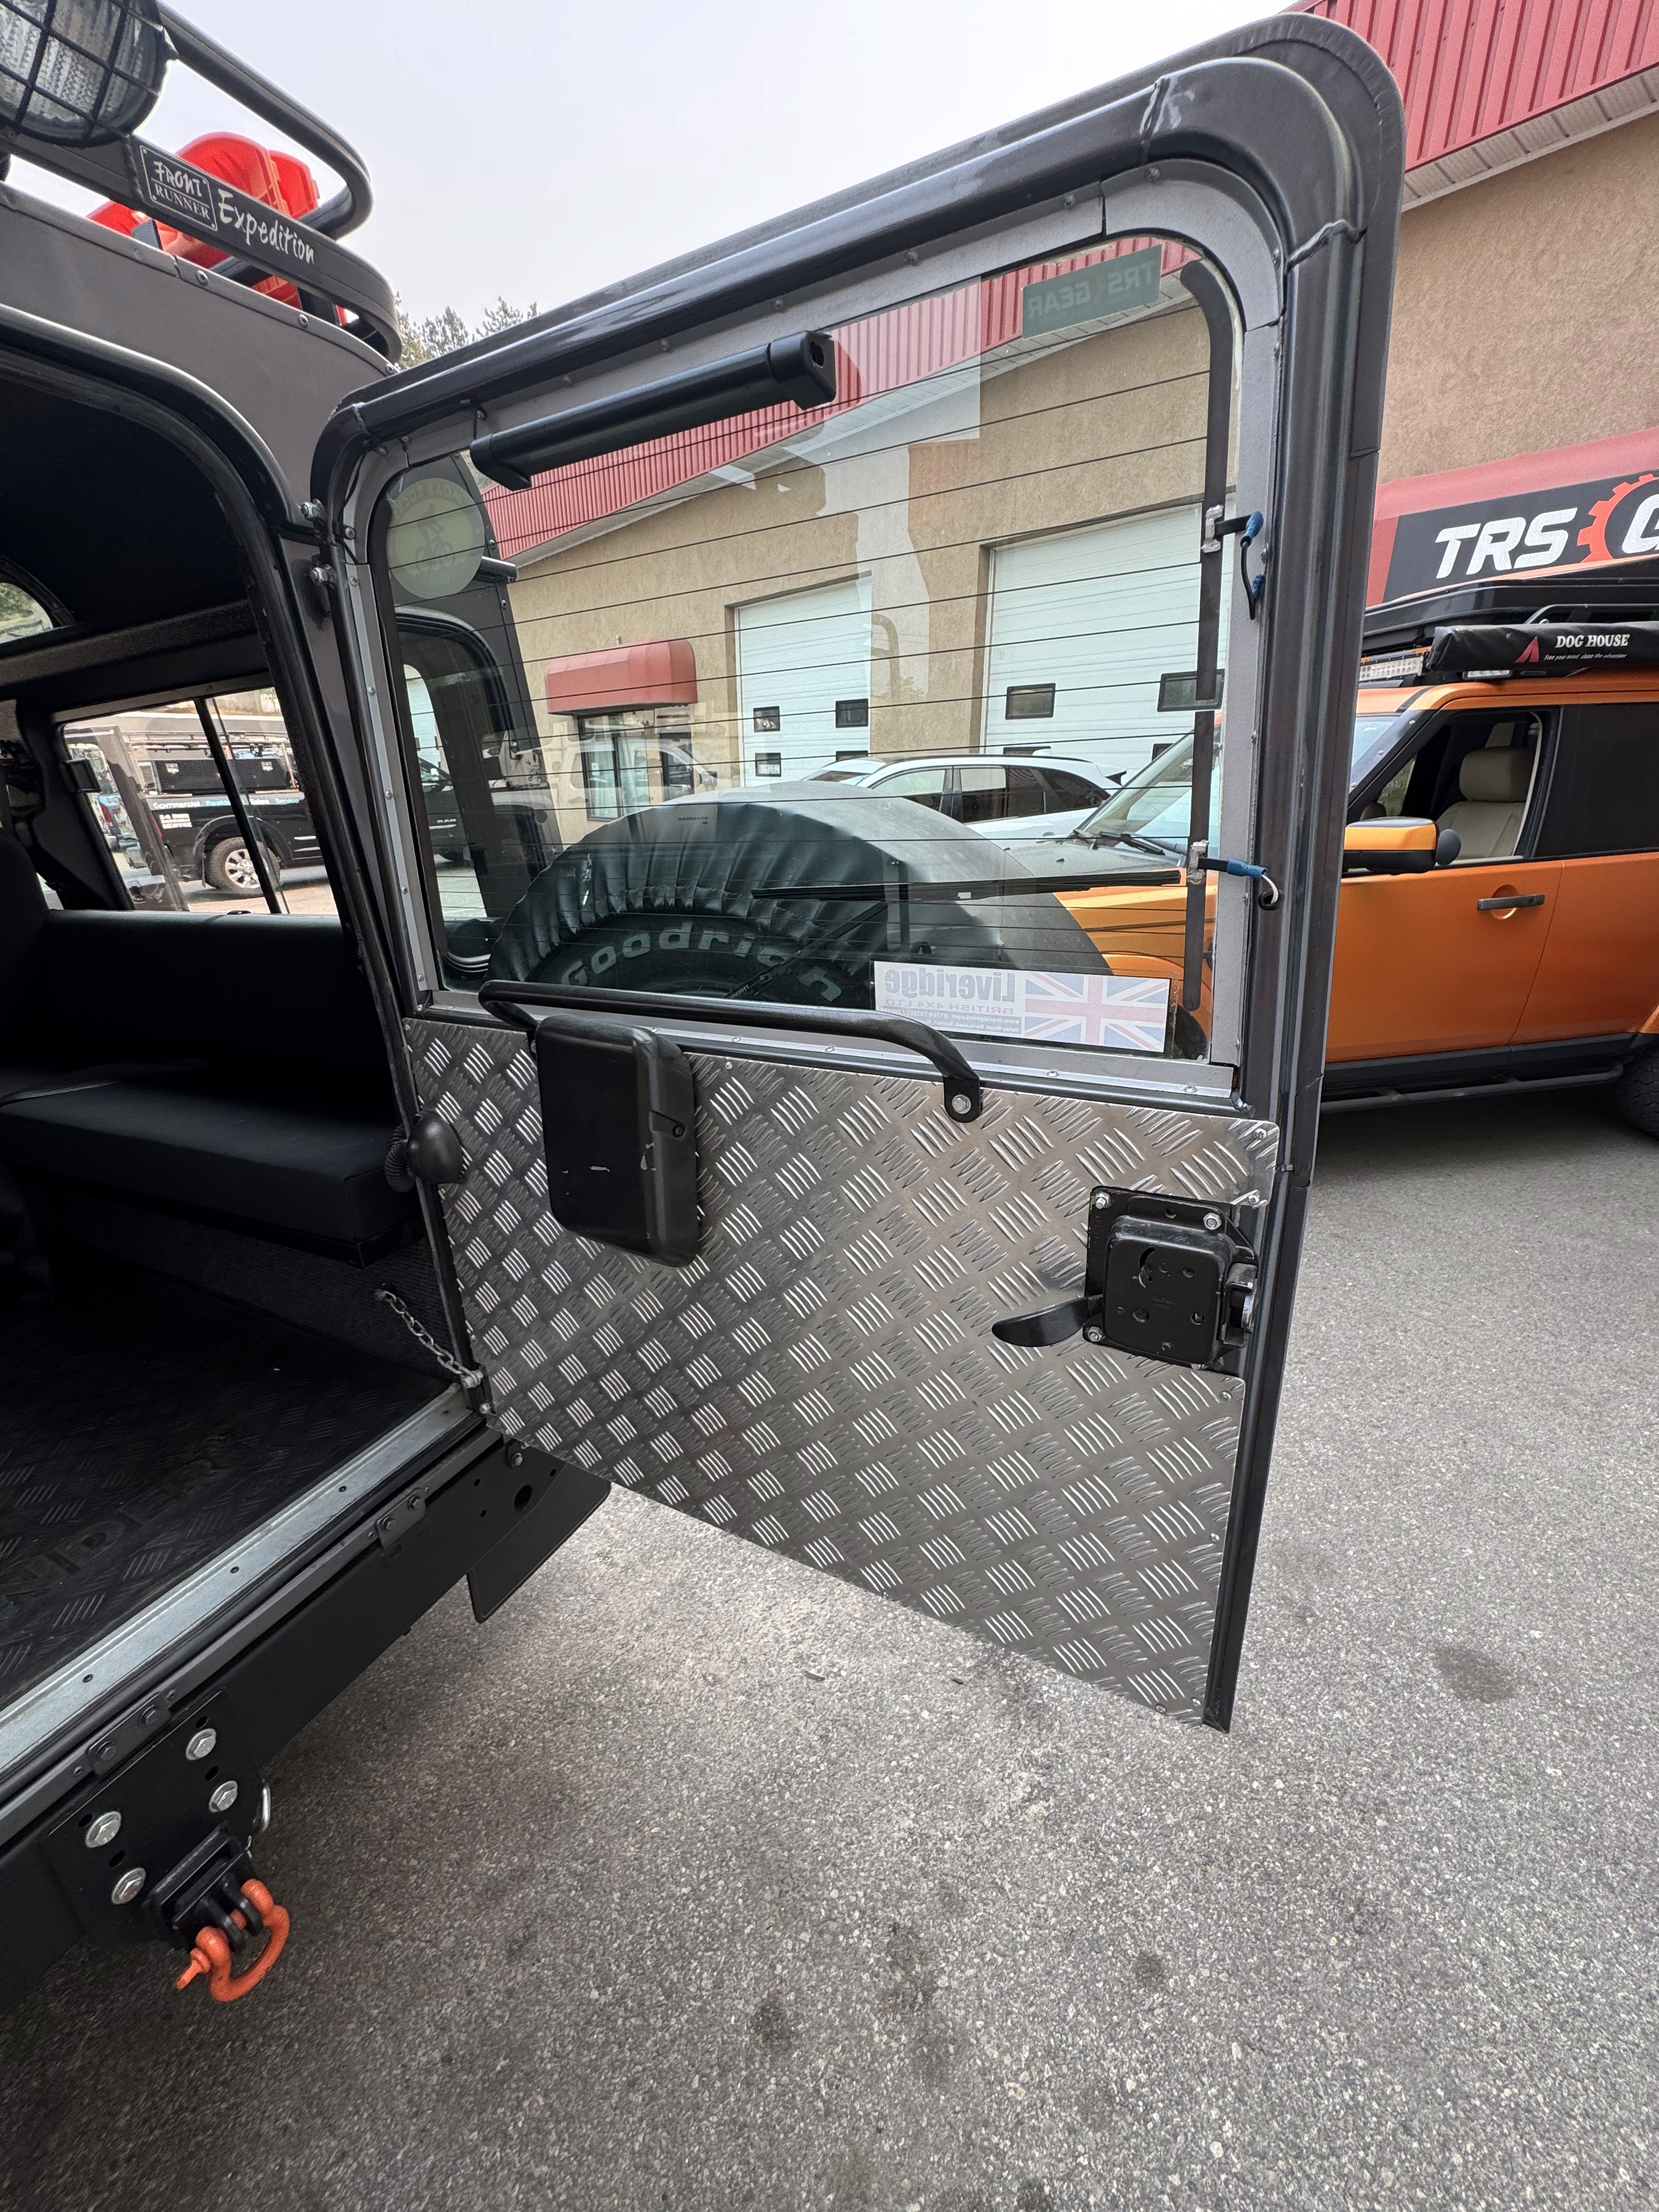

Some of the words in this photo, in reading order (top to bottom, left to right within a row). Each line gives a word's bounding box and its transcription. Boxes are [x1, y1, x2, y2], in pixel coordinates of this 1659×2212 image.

[153, 161, 202, 198] FRONT
[154, 183, 211, 220] RUNNER
[218, 188, 315, 265] Expedition
[1435, 507, 1578, 579] TRS
[1555, 635, 1584, 648] DOG
[1585, 634, 1630, 647] HOUSE
[153, 800, 201, 809] Commercial
